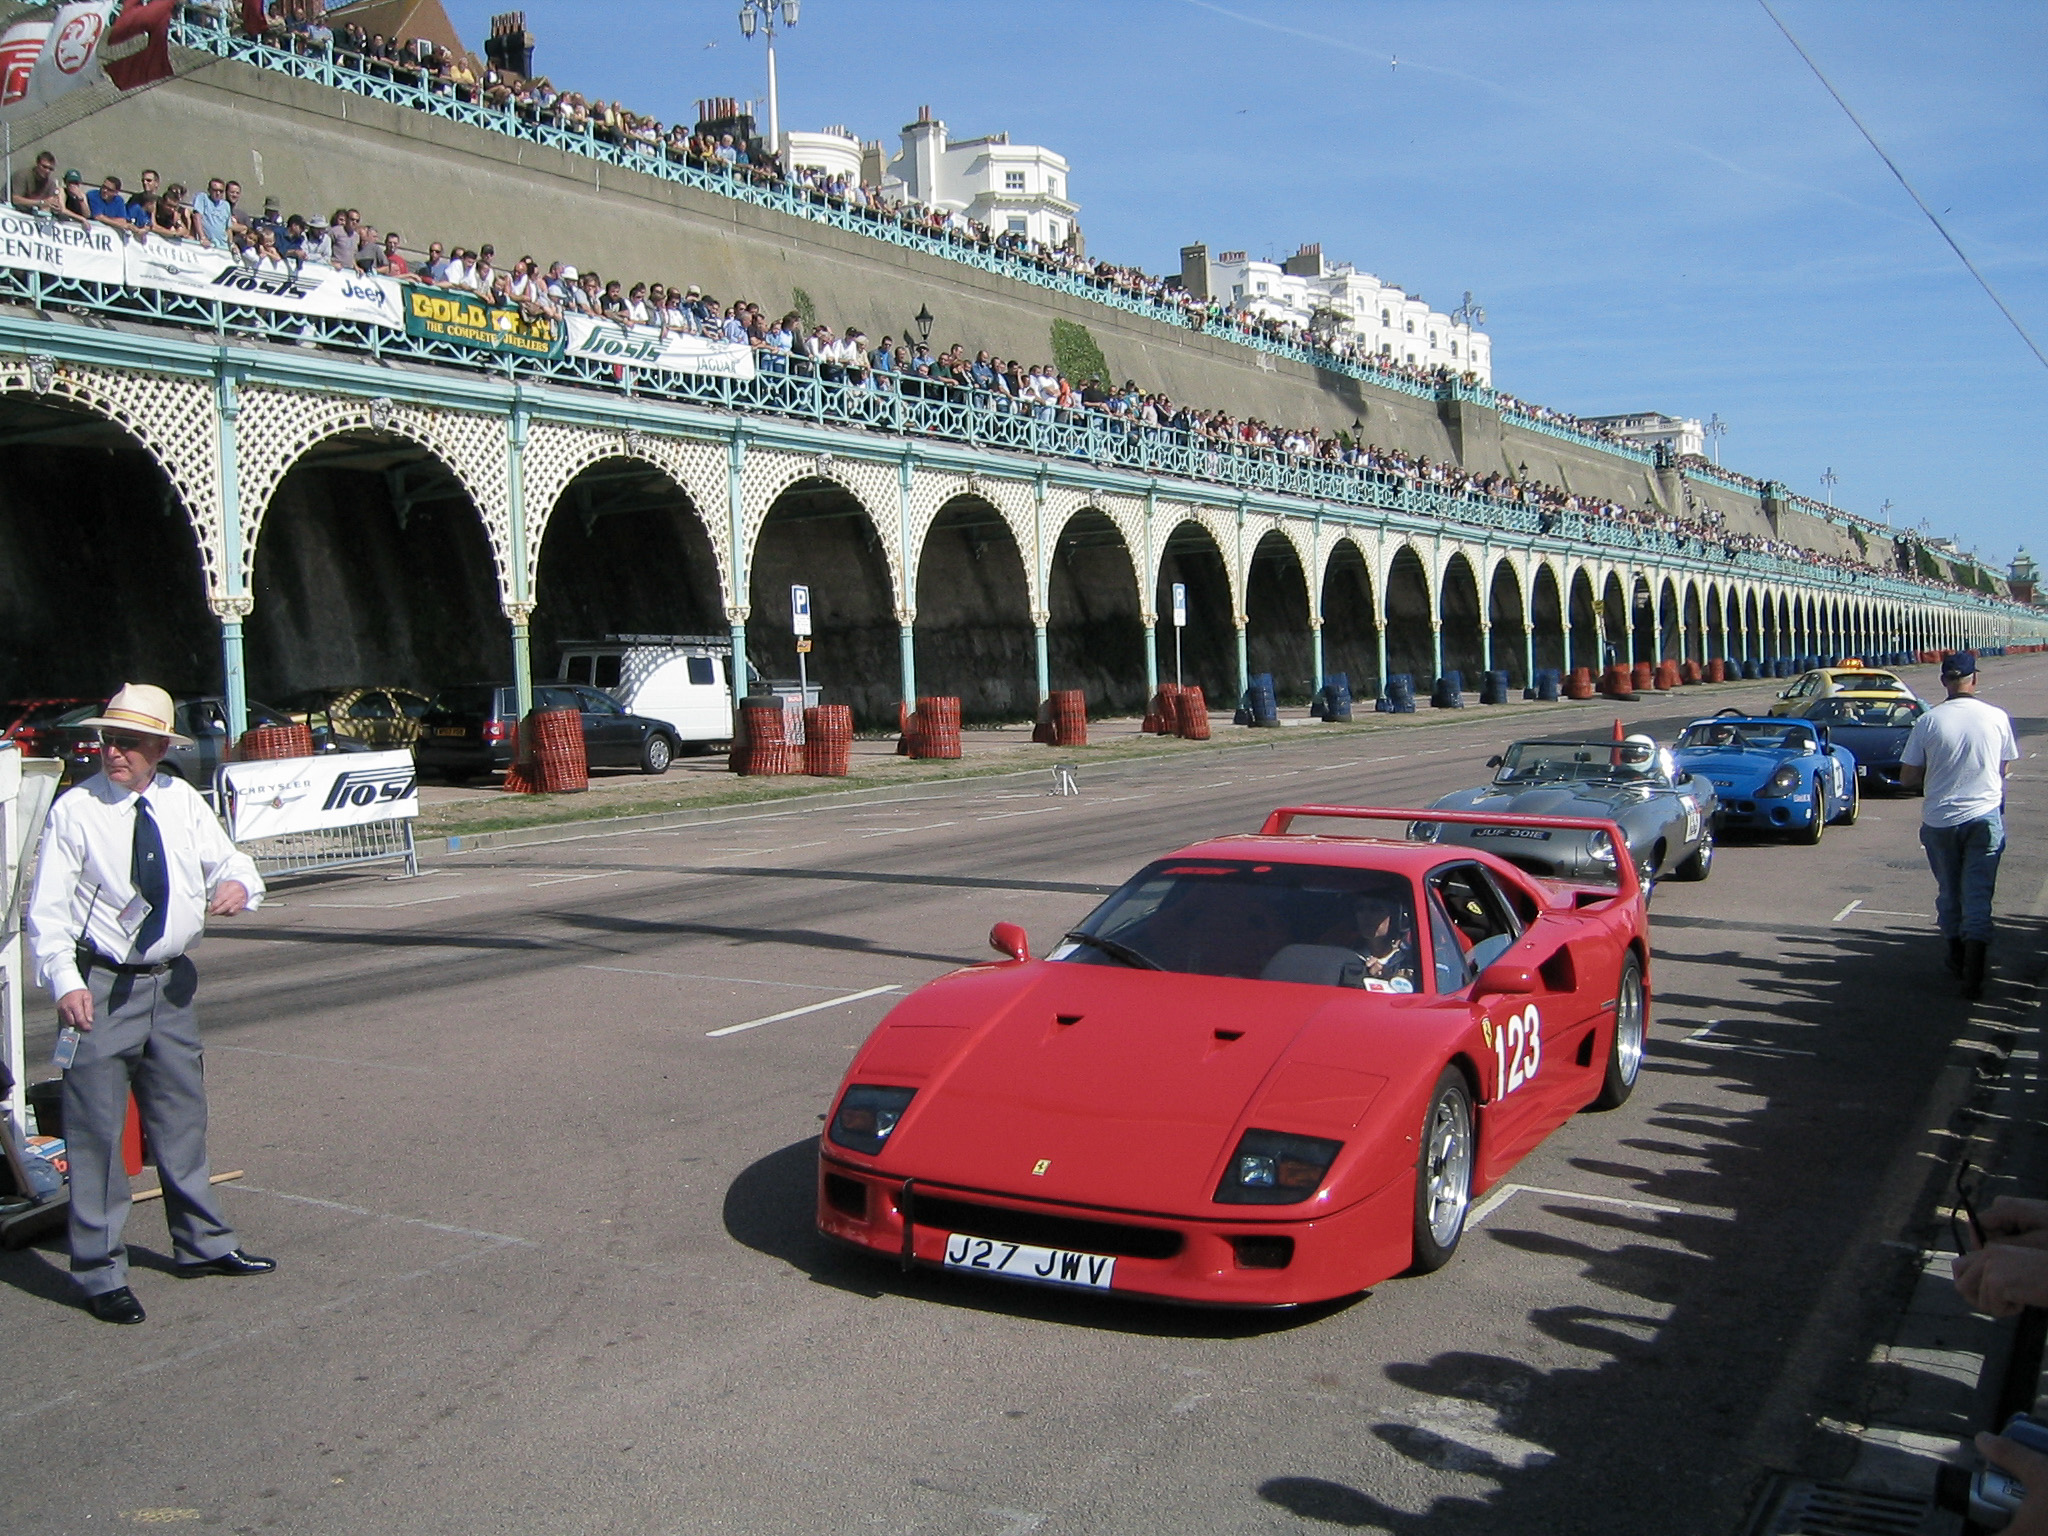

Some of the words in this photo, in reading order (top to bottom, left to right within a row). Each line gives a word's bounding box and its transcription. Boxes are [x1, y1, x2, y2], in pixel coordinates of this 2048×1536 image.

[52, 225, 113, 252] REPAIR
[341, 278, 386, 308] Jeep
[411, 293, 487, 328] GOLD
[426, 321, 444, 333] THE
[447, 325, 497, 343] COMPLETE
[696, 356, 736, 374] JAGUAR
[796, 589, 807, 614] P
[1176, 587, 1185, 608] P
[239, 780, 311, 796] CHRYSLER
[1495, 1003, 1541, 1102] 123
[949, 1237, 1020, 1270] J27
[1034, 1250, 1108, 1285] JWV
